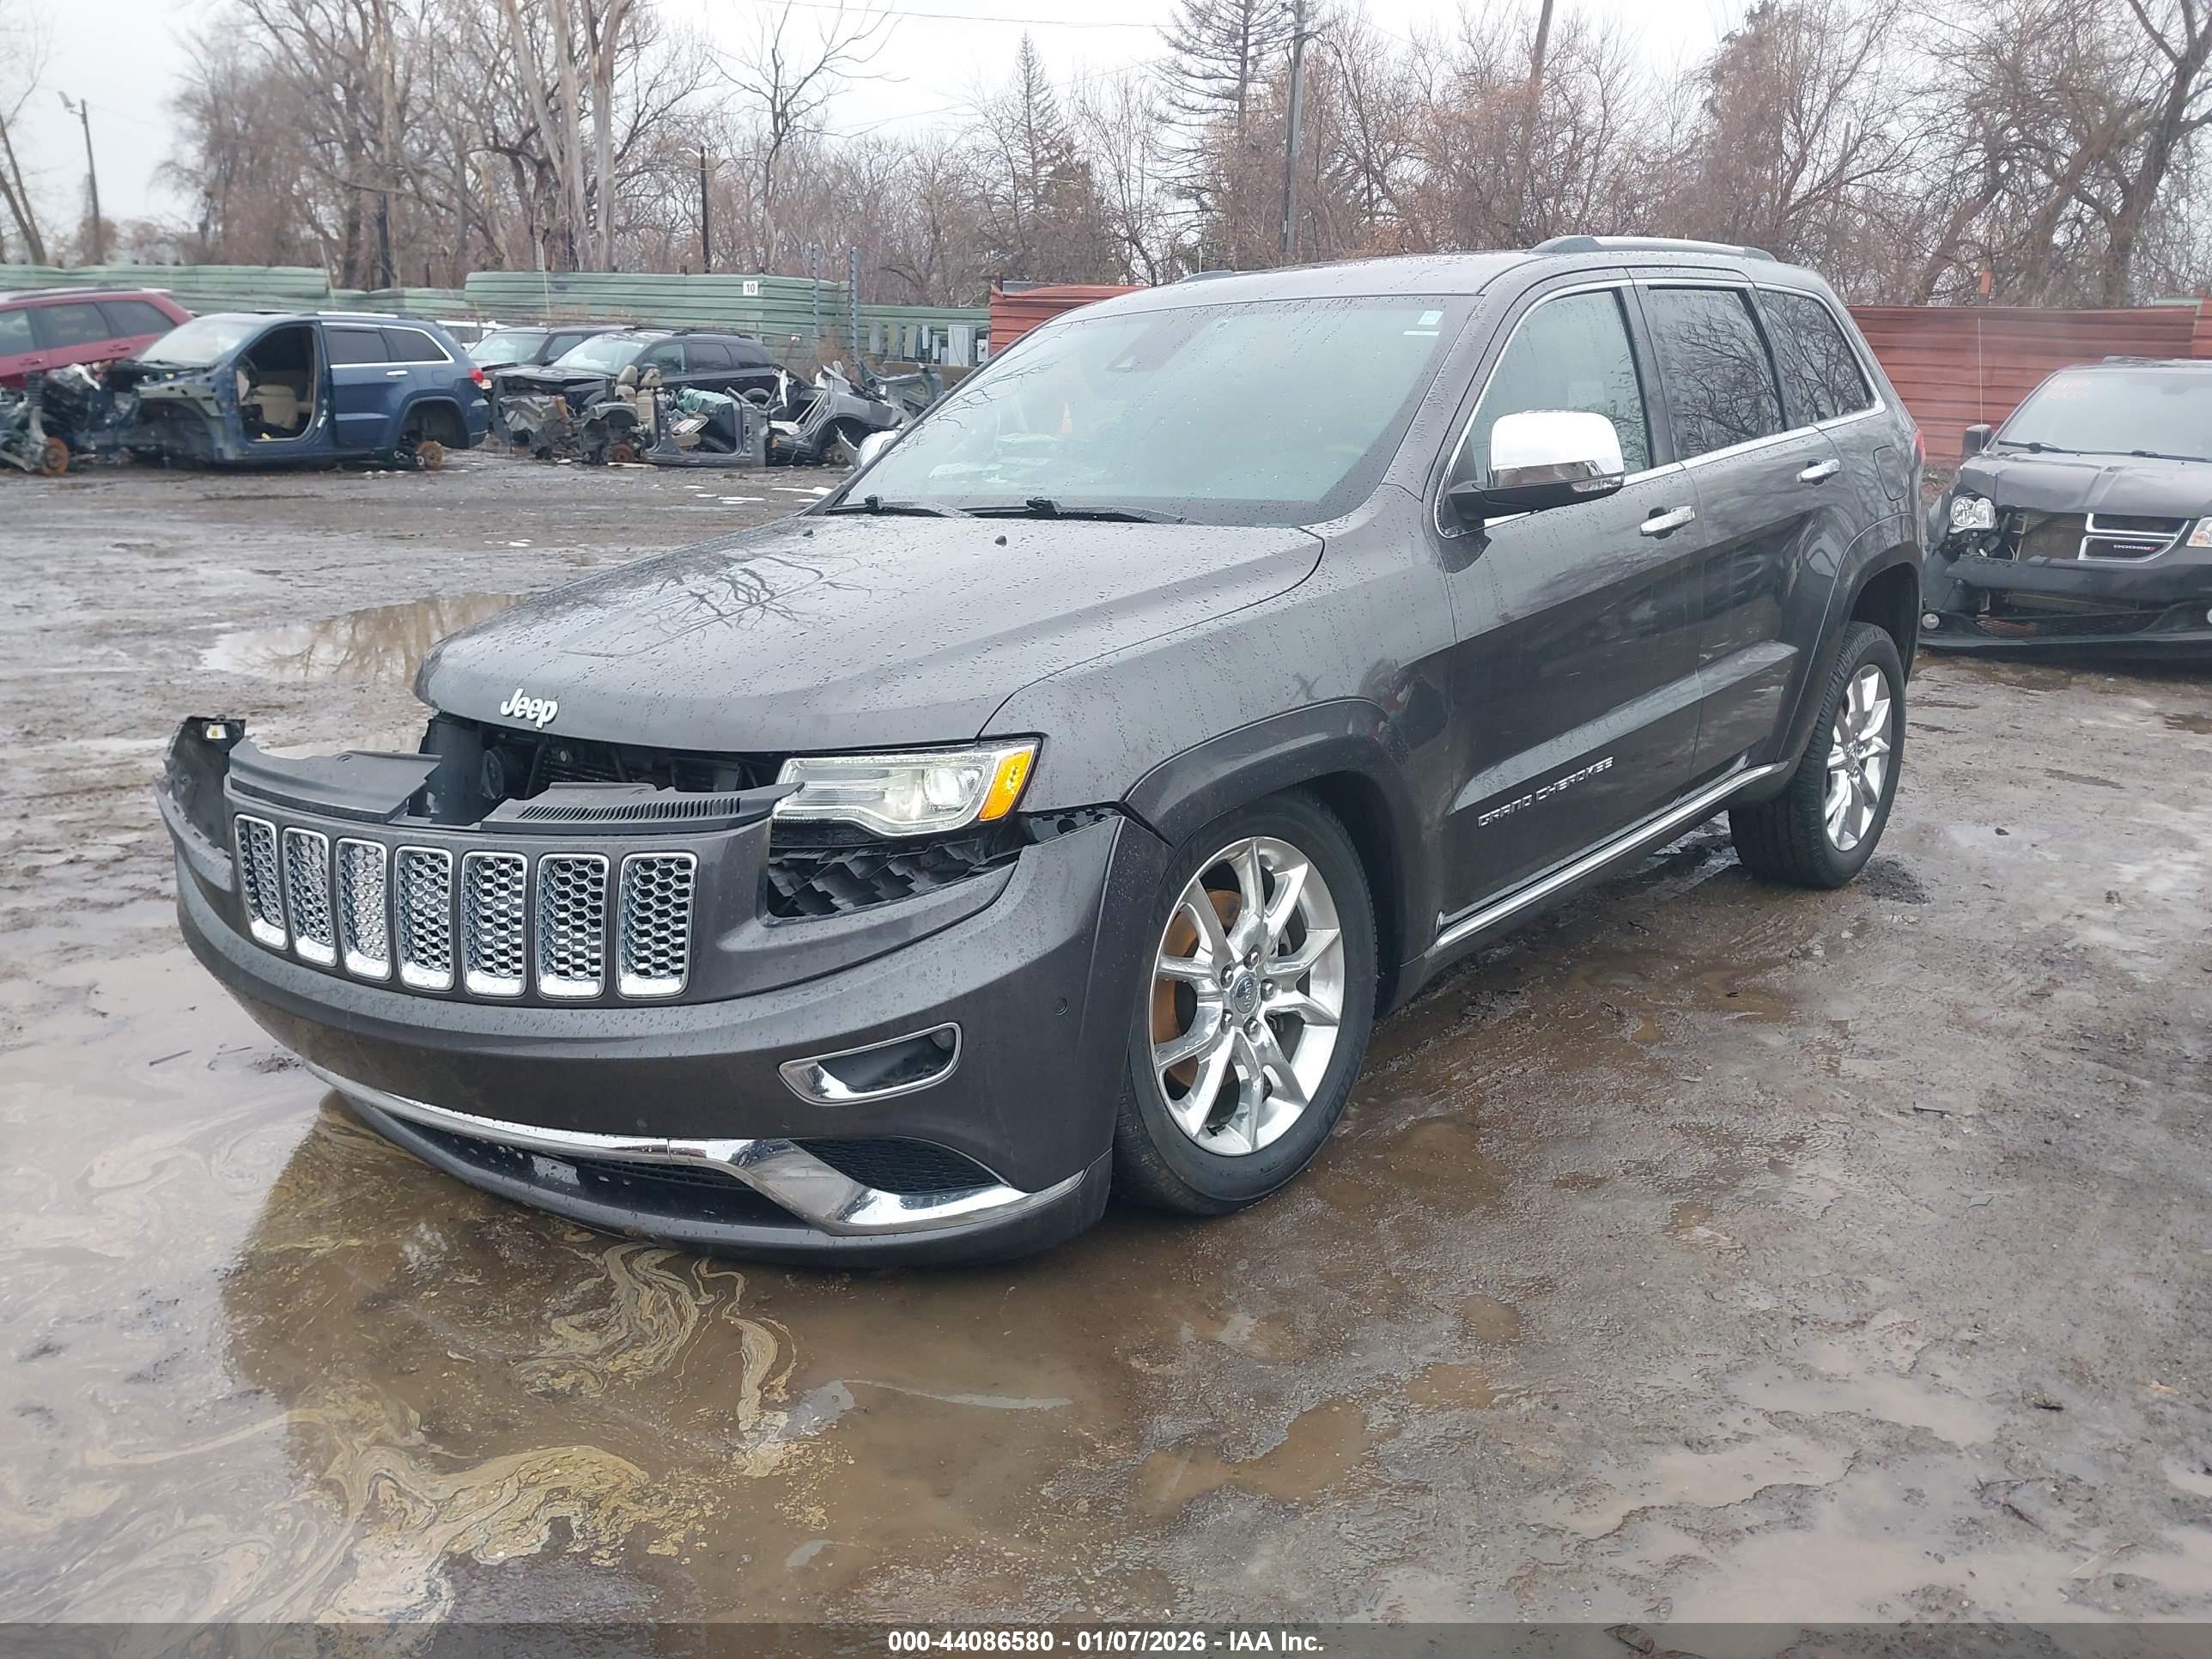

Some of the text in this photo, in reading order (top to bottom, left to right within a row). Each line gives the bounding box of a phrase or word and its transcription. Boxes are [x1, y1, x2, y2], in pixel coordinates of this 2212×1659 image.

[746, 283, 756, 294] 10
[500, 688, 559, 729] Jeep
[1478, 756, 1614, 828] GRAND CHEROKEE
